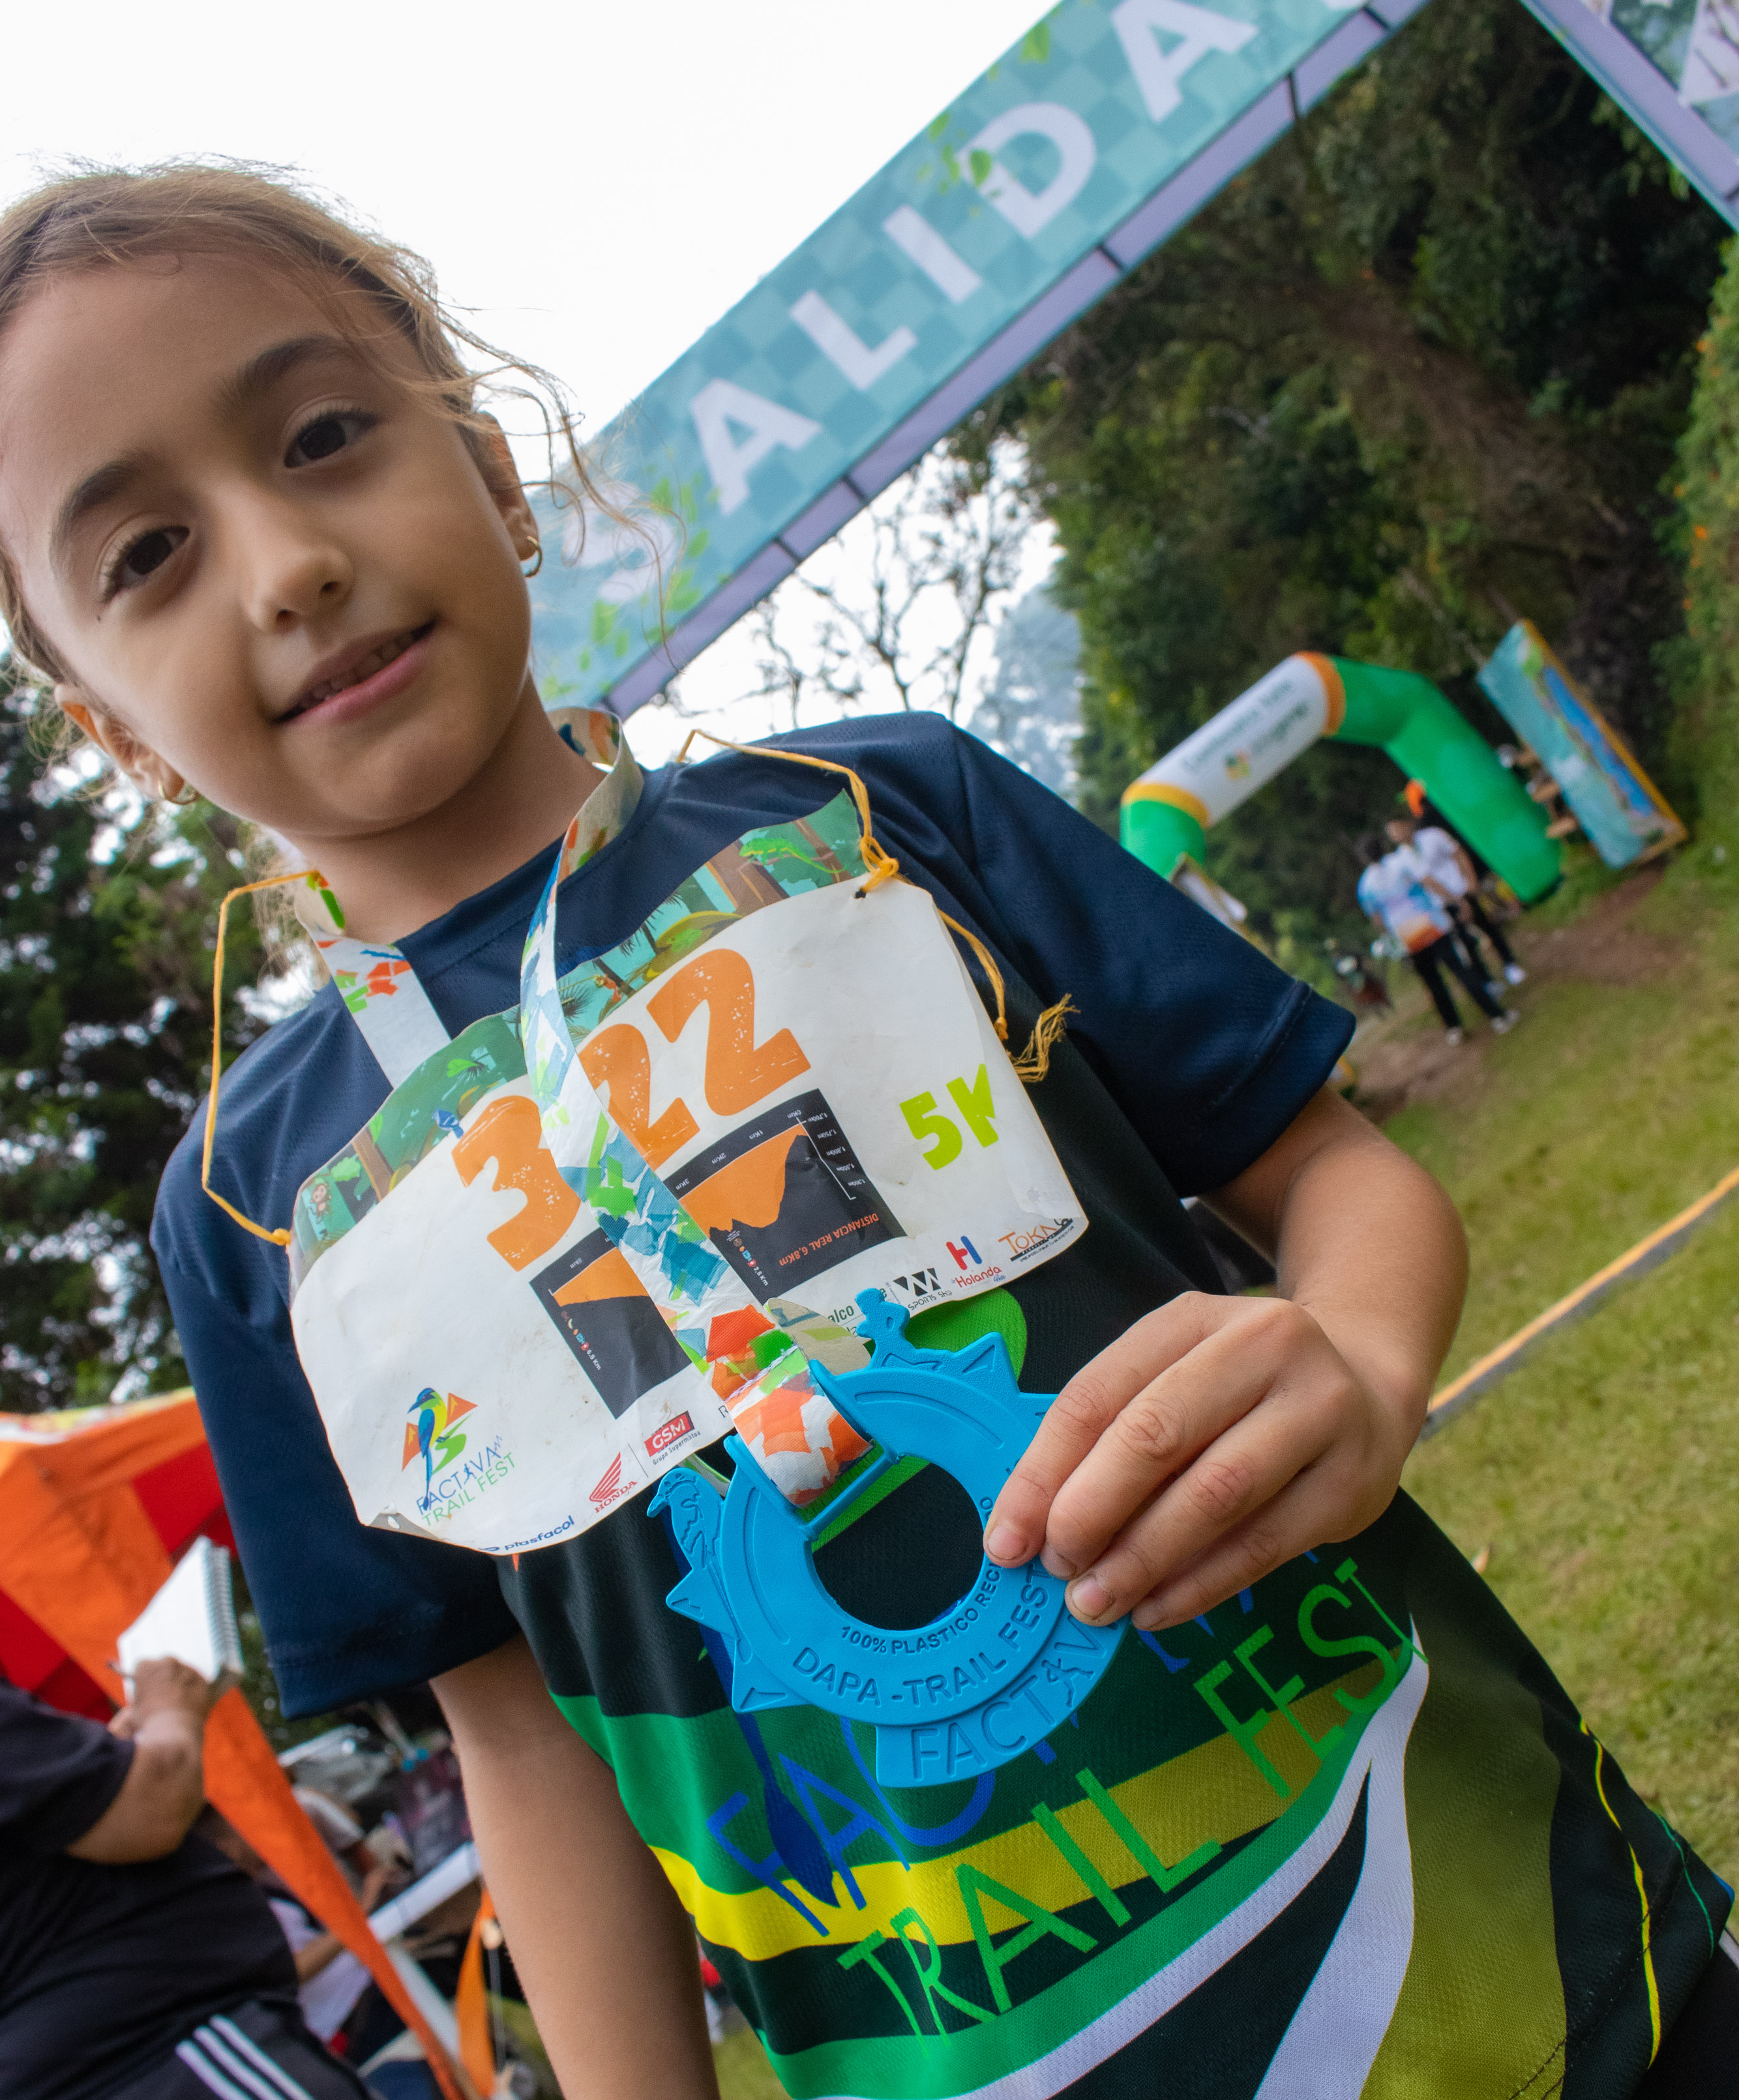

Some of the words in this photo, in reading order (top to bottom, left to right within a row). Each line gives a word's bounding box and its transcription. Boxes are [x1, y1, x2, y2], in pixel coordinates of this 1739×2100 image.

[451, 948, 811, 1272] 322
[899, 1064, 999, 1171] 5K
[749, 1130, 764, 1140] 1Km
[711, 1152, 726, 1164] 2Km
[676, 1178, 690, 1190] 3Km
[833, 1213, 879, 1239] DISTANCIA
[809, 1235, 833, 1251] REAL
[955, 1266, 1002, 1288] Holanda
[652, 1418, 686, 1449] GSM
[422, 1489, 475, 1526] TRAIL
[476, 1452, 515, 1493] FEST
[594, 1480, 638, 1513] HONDA
[998, 1563, 1052, 1651] FEST
[840, 1625, 888, 1654] 100%
[892, 1608, 979, 1655] PLASTICO
[836, 1767, 1221, 2058] TRAIL
[1194, 1557, 1429, 1800] FEST
